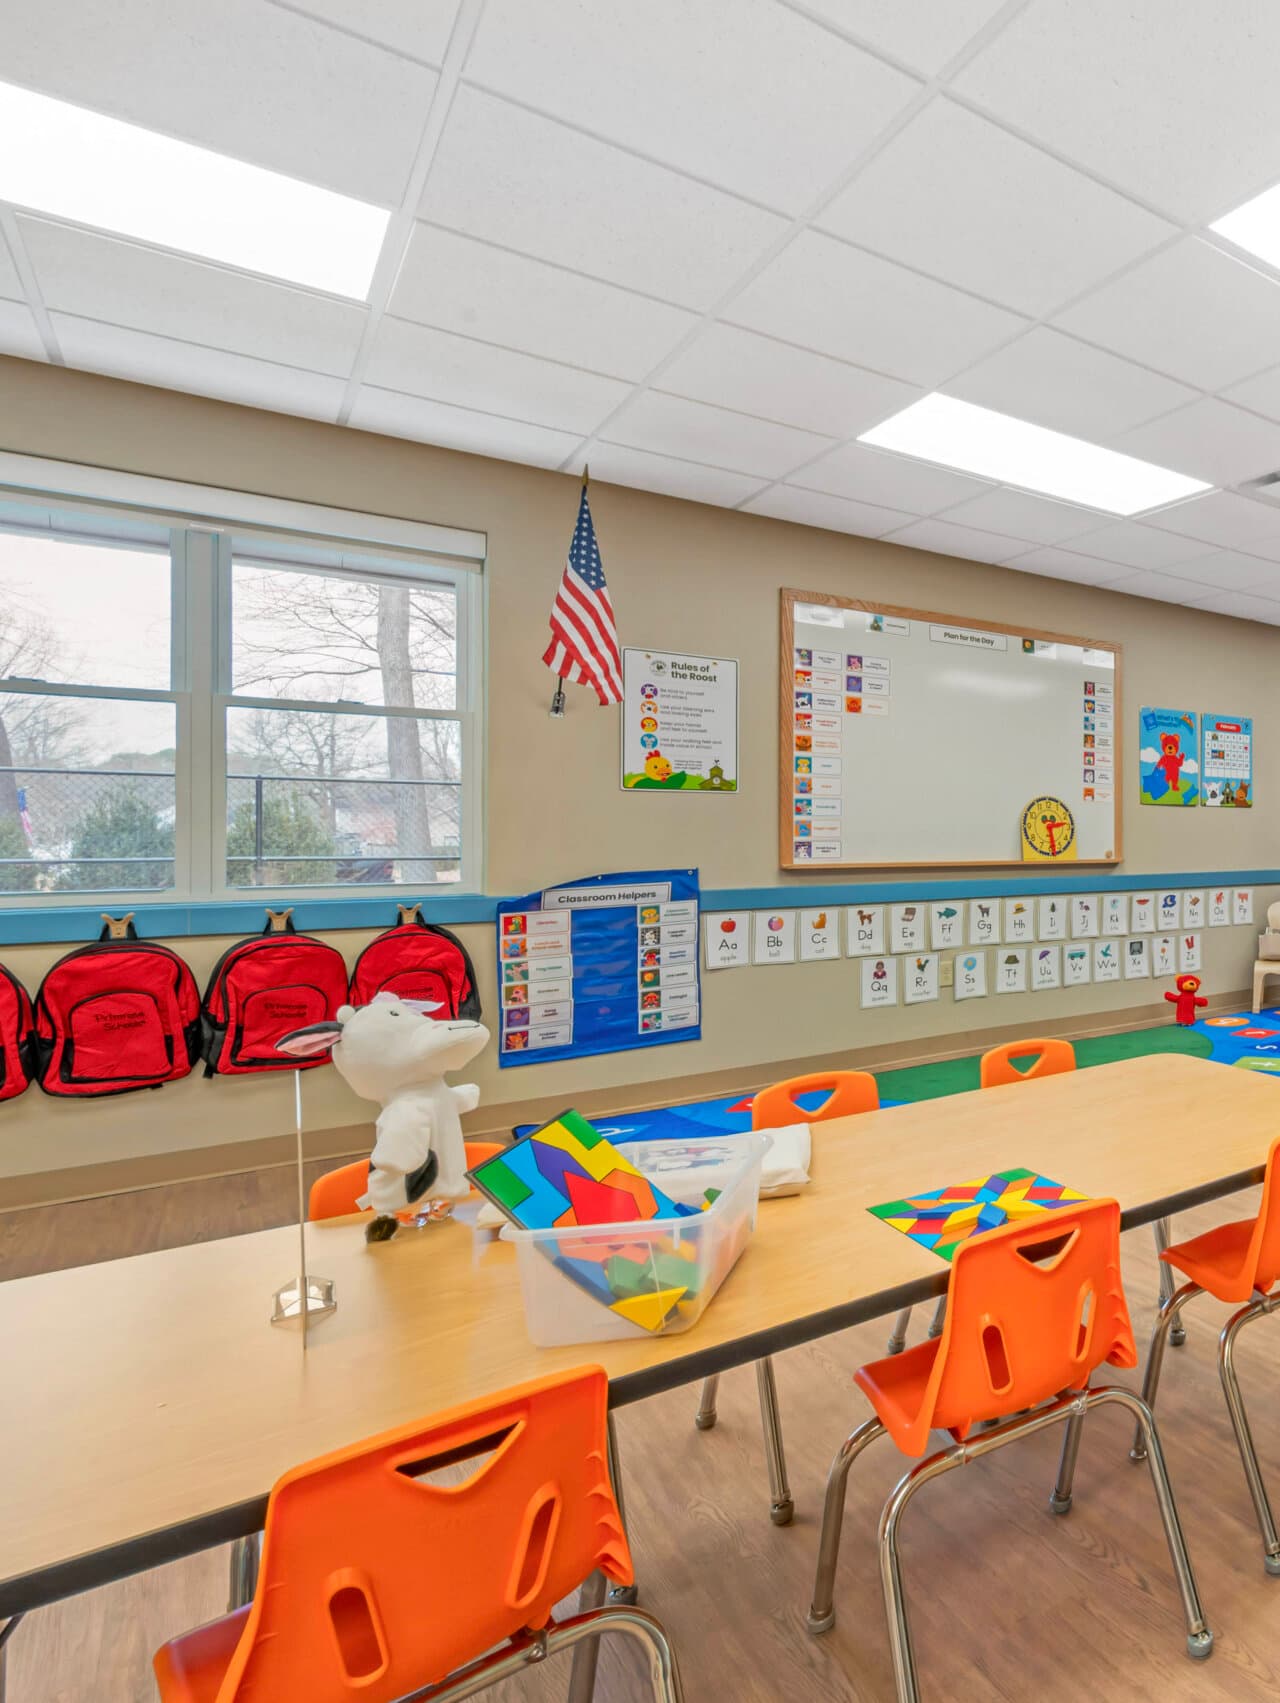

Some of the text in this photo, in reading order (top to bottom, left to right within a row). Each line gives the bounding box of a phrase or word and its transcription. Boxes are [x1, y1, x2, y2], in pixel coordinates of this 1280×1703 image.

[943, 631, 959, 640] Plan
[981, 637, 995, 646] Day
[671, 661, 698, 671] Rules
[699, 664, 710, 672] of
[671, 670, 717, 682] the Roost
[558, 891, 657, 904] Classroom Helpers
[1163, 910, 1175, 918] Mm
[1189, 909, 1199, 917] Nn
[941, 923, 953, 934] Ff
[977, 919, 992, 933] Gg
[1013, 920, 1025, 929] Hh
[811, 933, 828, 944] Cc
[858, 929, 873, 940] Dd
[902, 928, 915, 939] Ee
[718, 939, 738, 951] Aa
[767, 936, 783, 947] Bb
[1071, 963, 1082, 972] Vv
[1097, 960, 1117, 969] Ww
[1006, 969, 1017, 978] Tt
[1040, 967, 1051, 976] Uu
[916, 977, 928, 987] Rr
[965, 975, 975, 984] Ss
[871, 981, 888, 992] Qq
